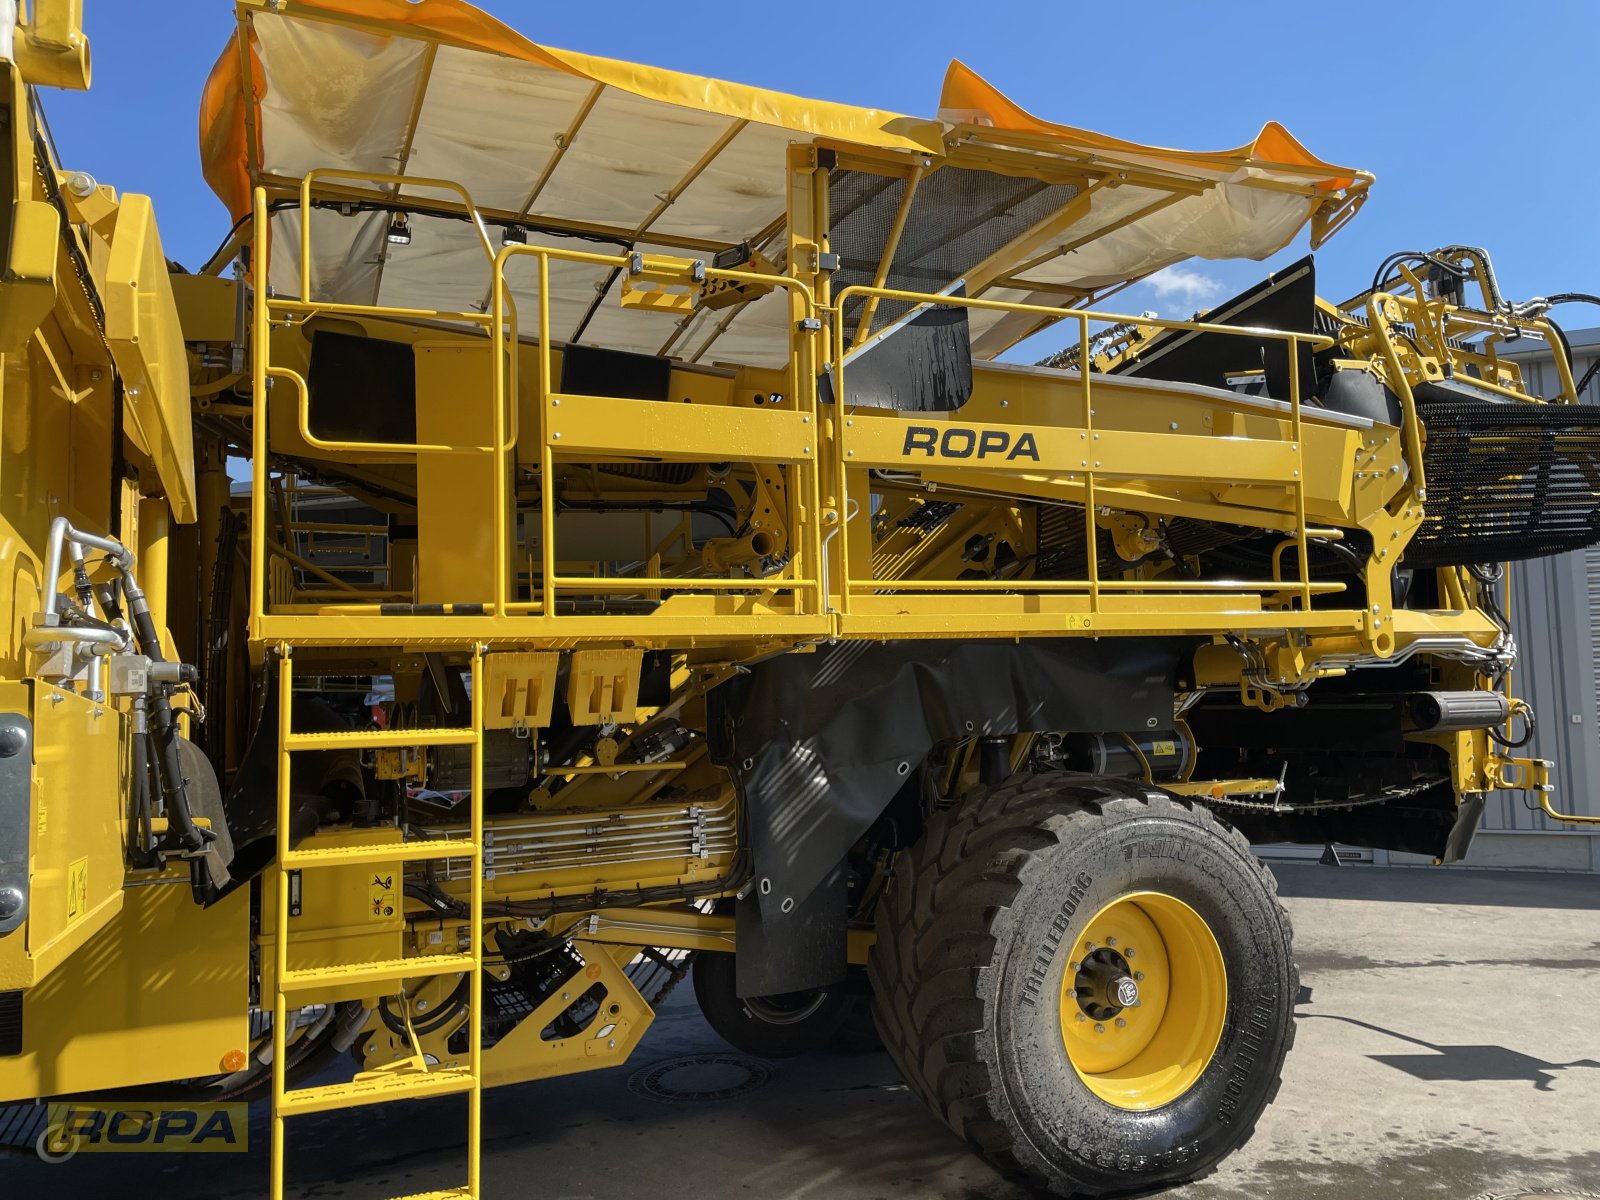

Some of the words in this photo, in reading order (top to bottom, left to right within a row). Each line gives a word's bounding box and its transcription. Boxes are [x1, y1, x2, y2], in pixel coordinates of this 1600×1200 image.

[902, 426, 1041, 462] ROPA
[1122, 839, 1190, 863] TWIN
[1017, 871, 1093, 1007] TRELLEBORG
